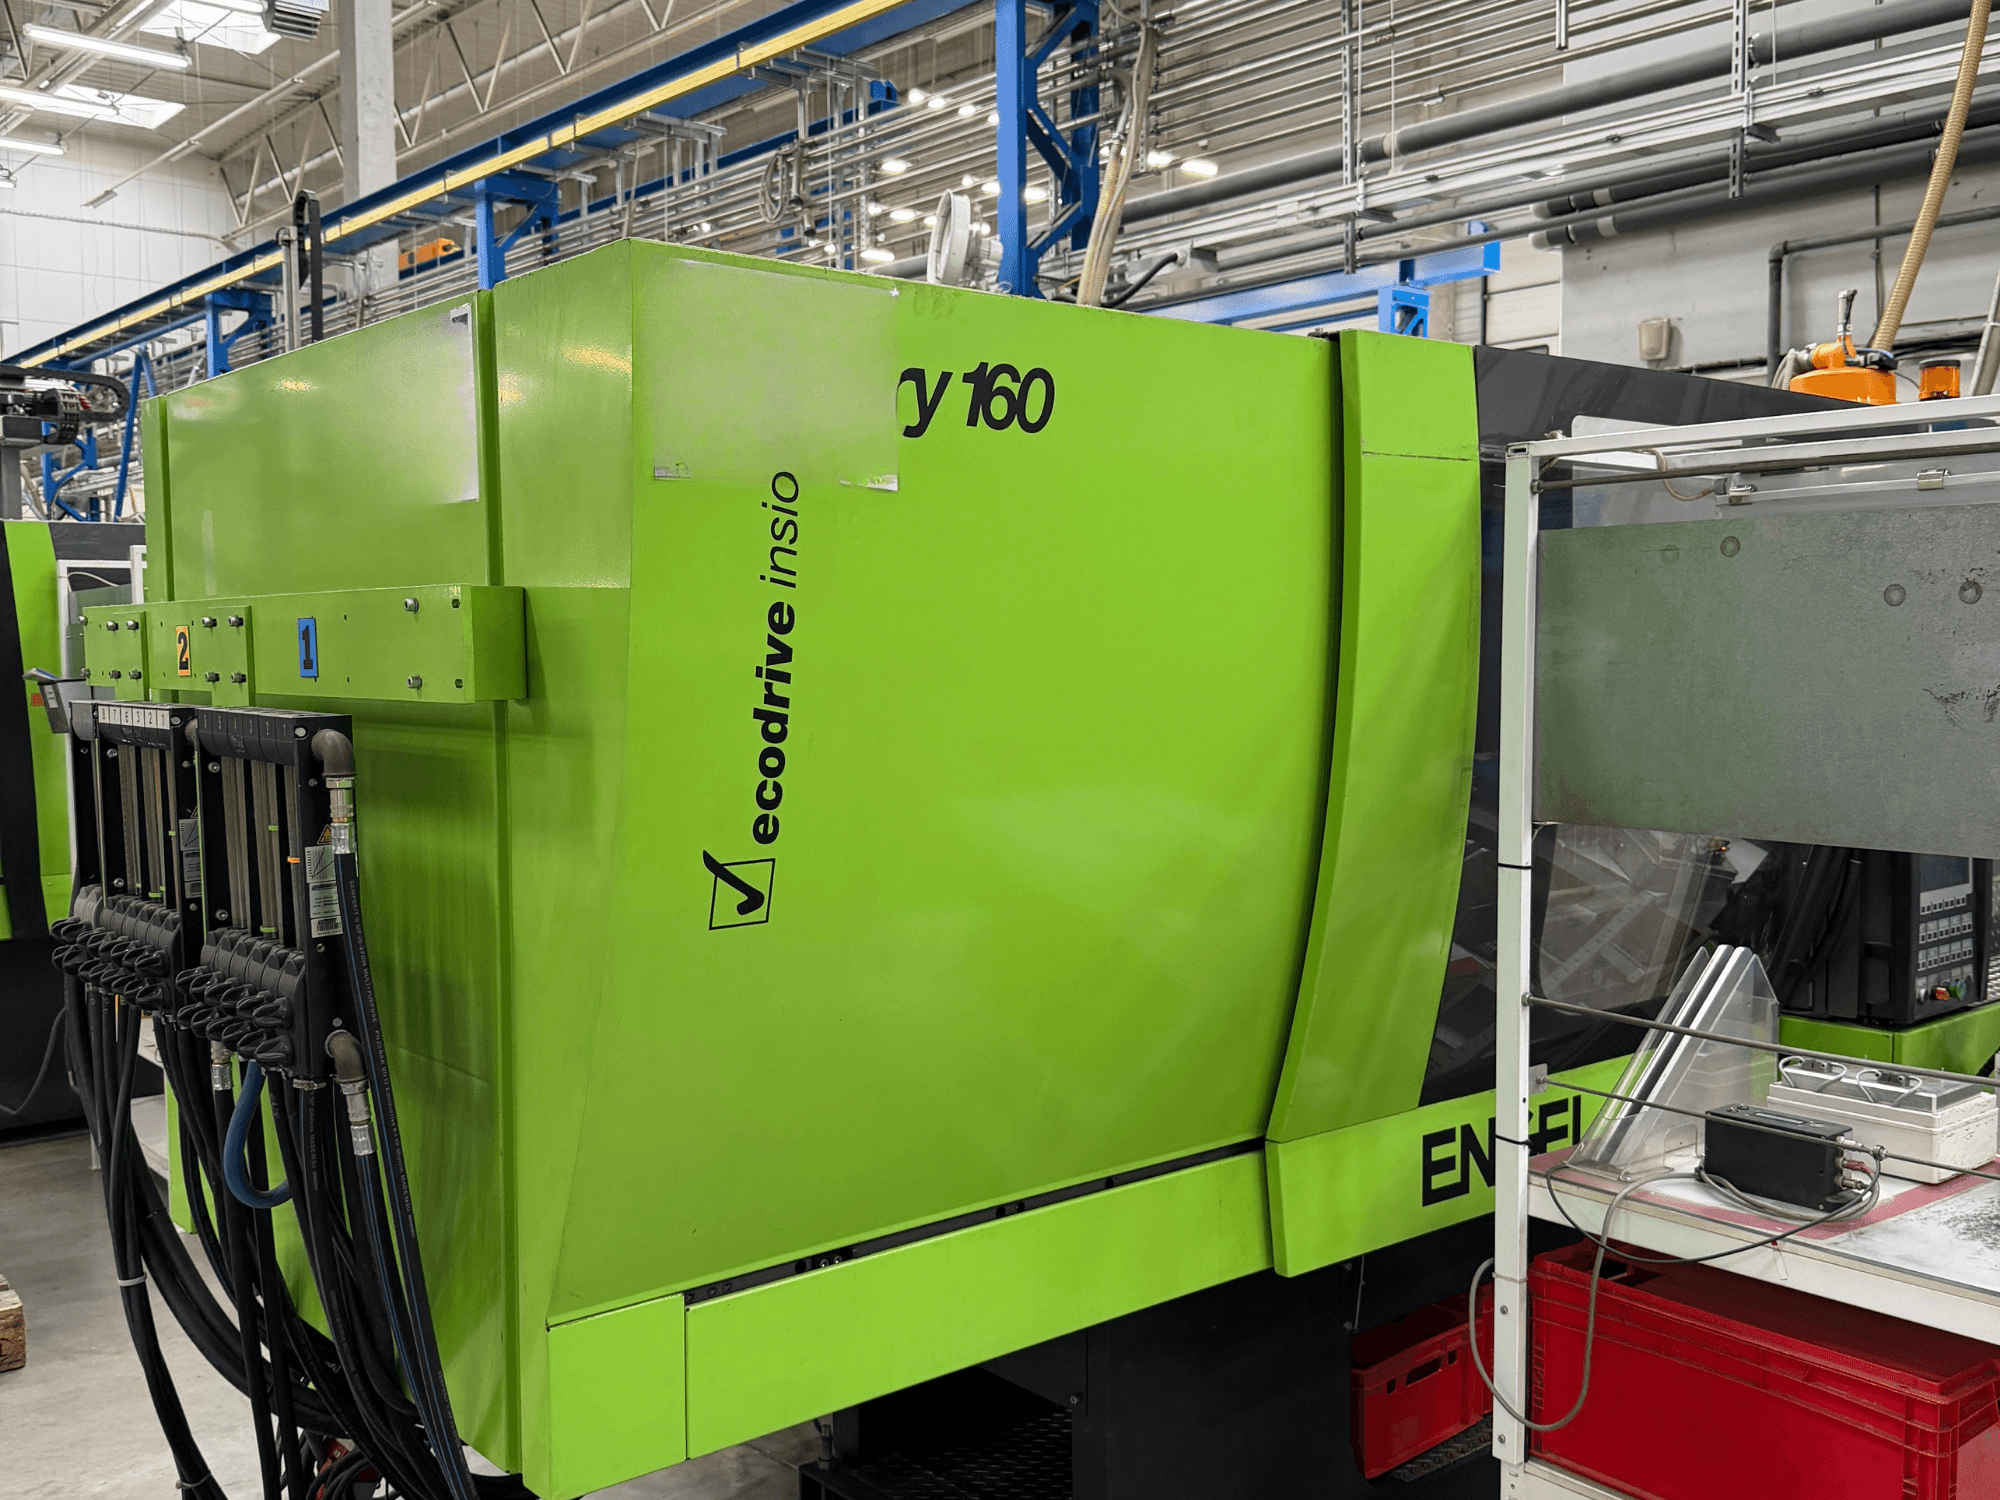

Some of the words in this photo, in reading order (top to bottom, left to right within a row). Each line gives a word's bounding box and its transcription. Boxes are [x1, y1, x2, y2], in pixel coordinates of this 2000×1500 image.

[962, 362, 1055, 433] 160
[177, 631, 189, 670] 2
[301, 625, 314, 670] 1
[753, 602, 795, 845] ecodrive
[1423, 1095, 1581, 1207] ENE
